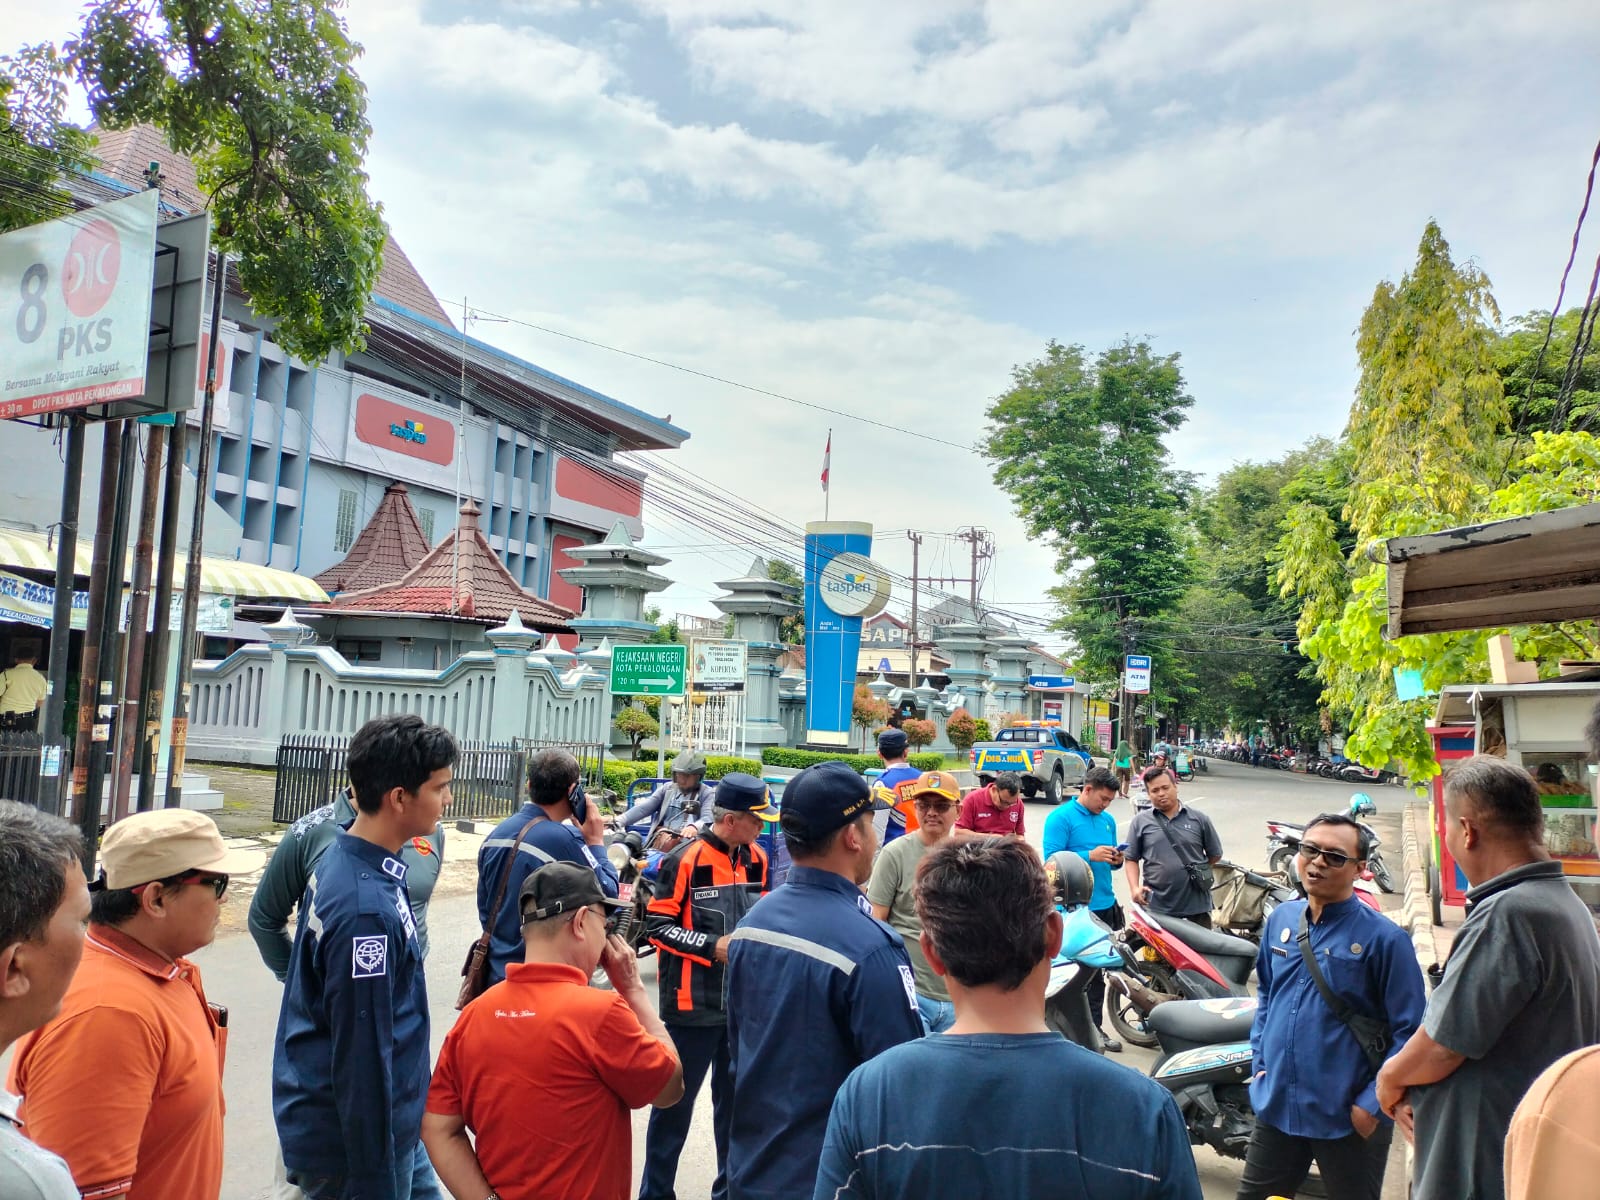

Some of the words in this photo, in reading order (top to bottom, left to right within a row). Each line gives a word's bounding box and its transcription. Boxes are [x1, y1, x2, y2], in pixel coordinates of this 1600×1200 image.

[16, 263, 49, 344] 8
[57, 317, 113, 361] PKS
[5, 377, 42, 391] Bersama
[44, 367, 84, 384] Melayani
[86, 360, 120, 376] Rakyat
[66, 391, 84, 403] KOTA
[84, 383, 132, 400] PEKALONGAN
[827, 580, 871, 595] taspen
[3, 609, 46, 625] PEKALONGAN
[616, 651, 655, 663] KEJAKSAAN
[656, 651, 681, 663] NEGERI
[615, 663, 633, 672] KOTA
[634, 664, 681, 673] PEKALONGAN
